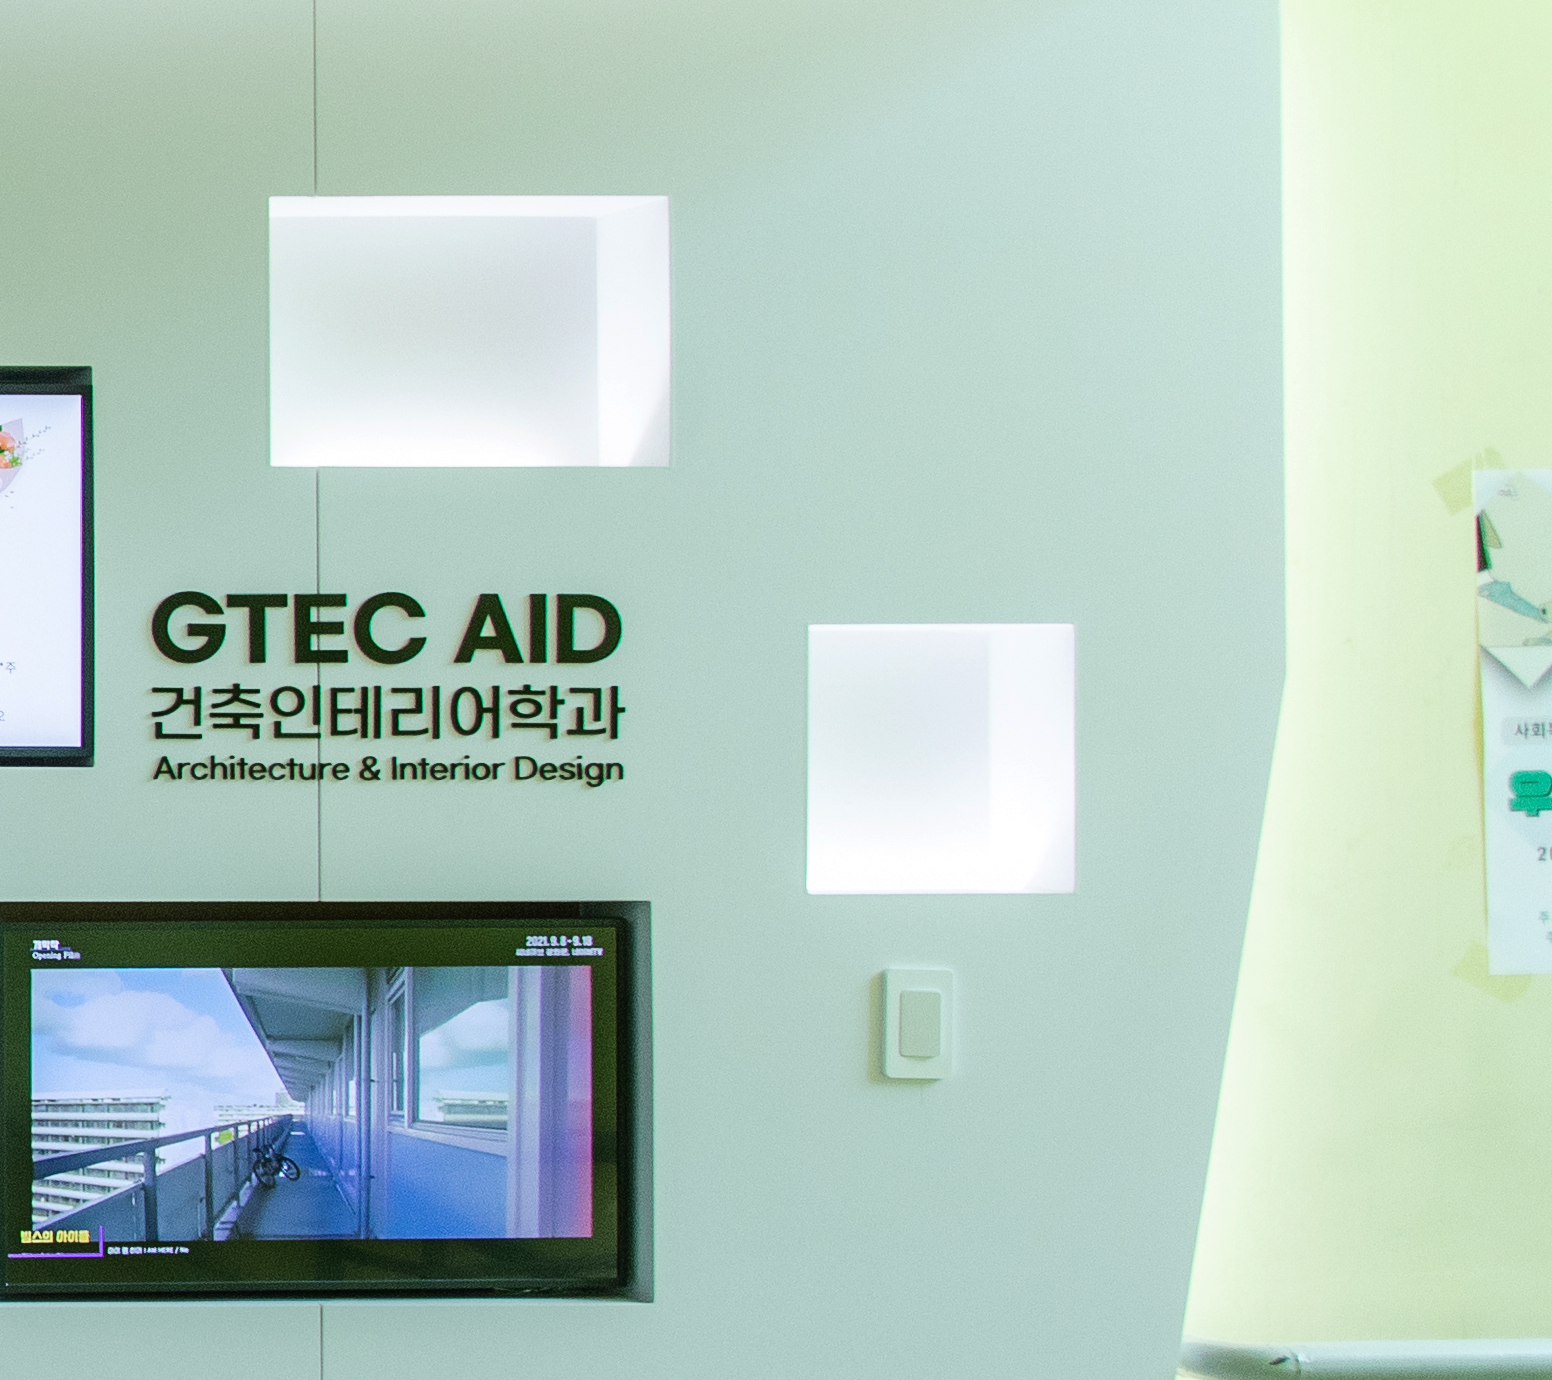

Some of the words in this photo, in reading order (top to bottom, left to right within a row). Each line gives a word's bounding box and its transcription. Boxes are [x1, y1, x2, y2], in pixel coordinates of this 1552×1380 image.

[152, 592, 427, 664] GTEC
[454, 594, 621, 663] AID
[151, 684, 626, 740] 건축인테리어학과
[153, 756, 350, 781] Architecture
[359, 756, 380, 781] &
[391, 755, 505, 780] Interior
[514, 756, 624, 787] Design
